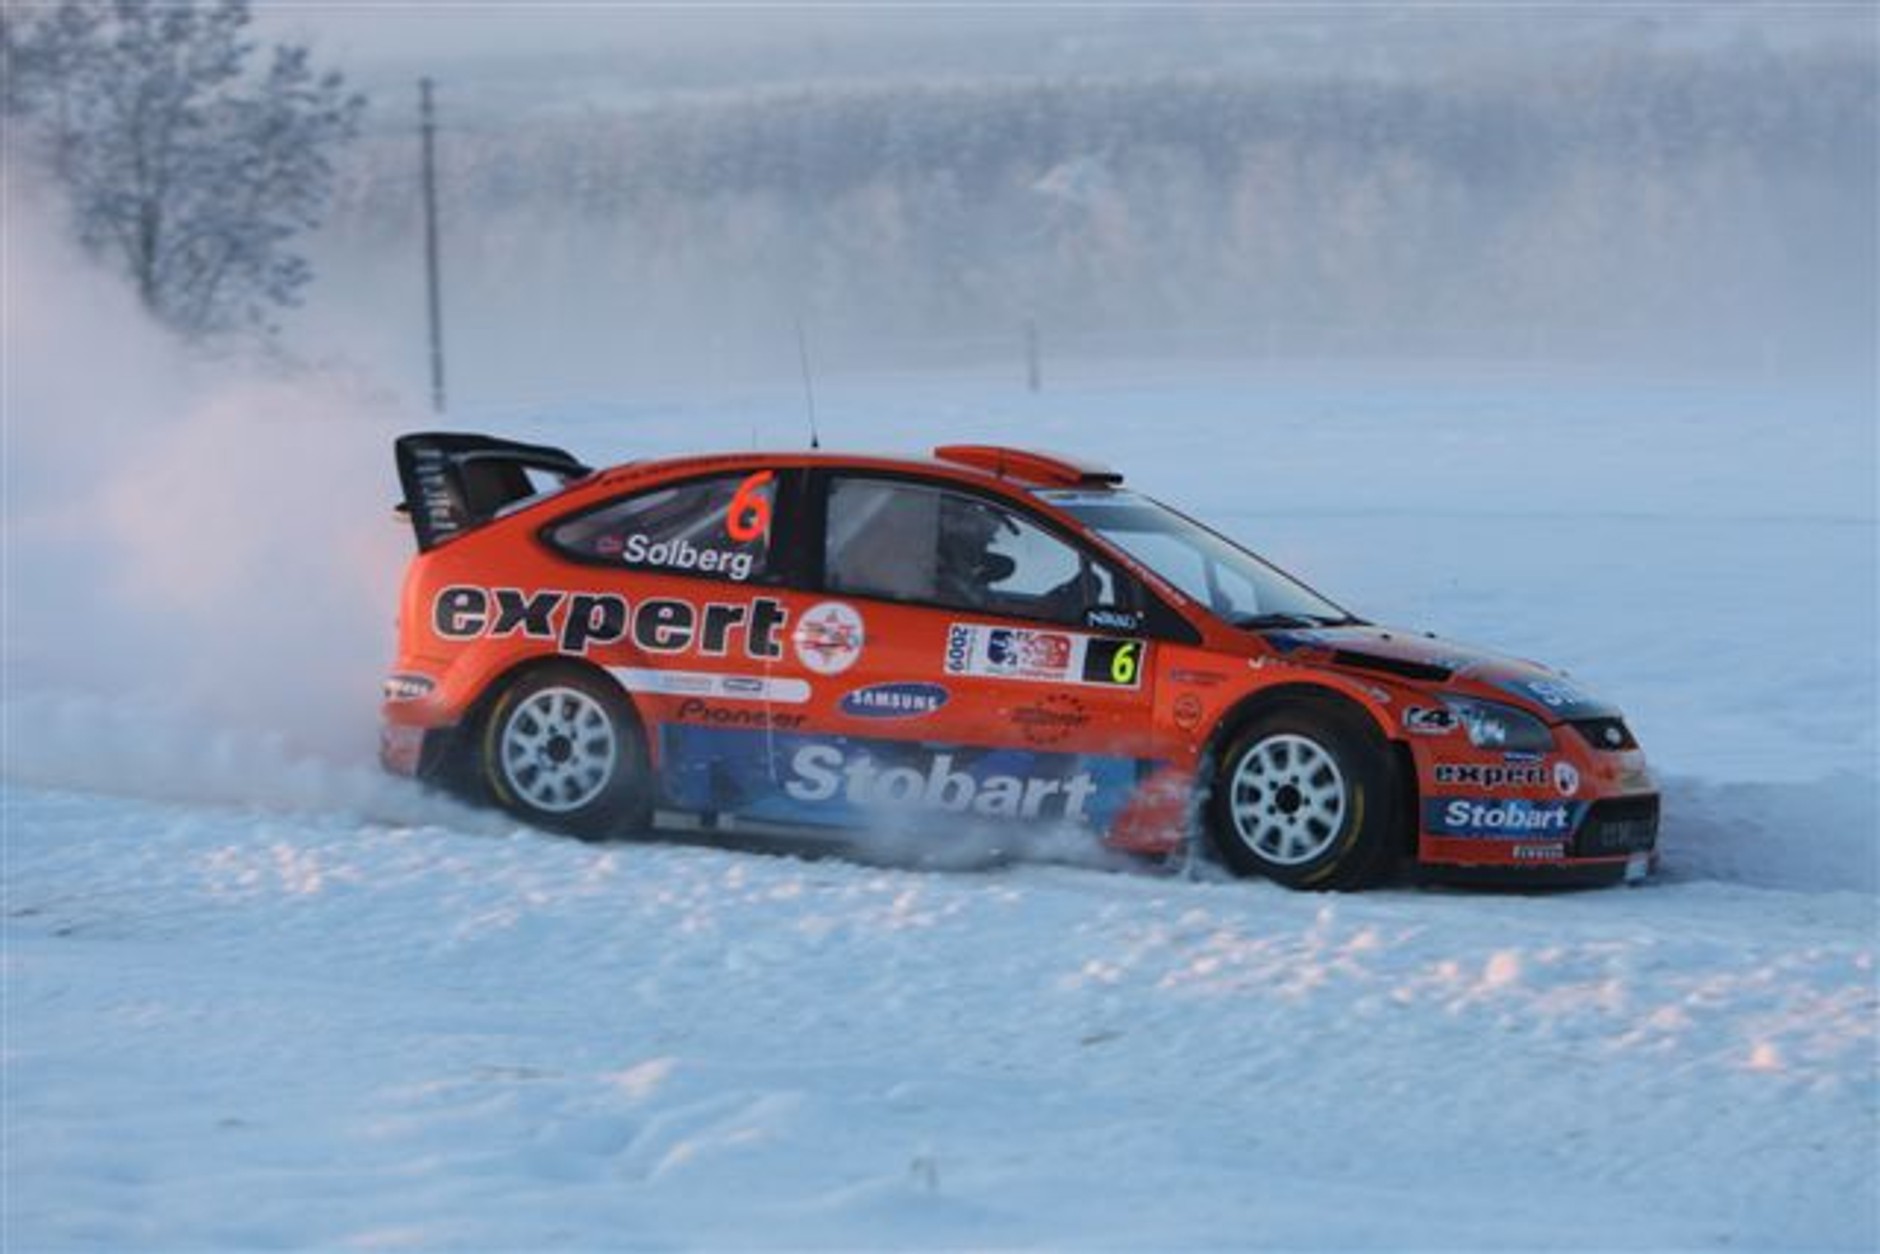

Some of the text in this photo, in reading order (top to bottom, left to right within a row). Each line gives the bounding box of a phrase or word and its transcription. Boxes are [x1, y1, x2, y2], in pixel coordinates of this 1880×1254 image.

[726, 470, 774, 543] 6
[622, 534, 754, 580] Solberg
[432, 583, 786, 659] expert
[948, 626, 968, 671] 2009
[1110, 642, 1136, 684] 6
[852, 690, 938, 712] SAMSUNG
[784, 744, 1097, 822] Stobart
[1444, 801, 1568, 829] Stobart
